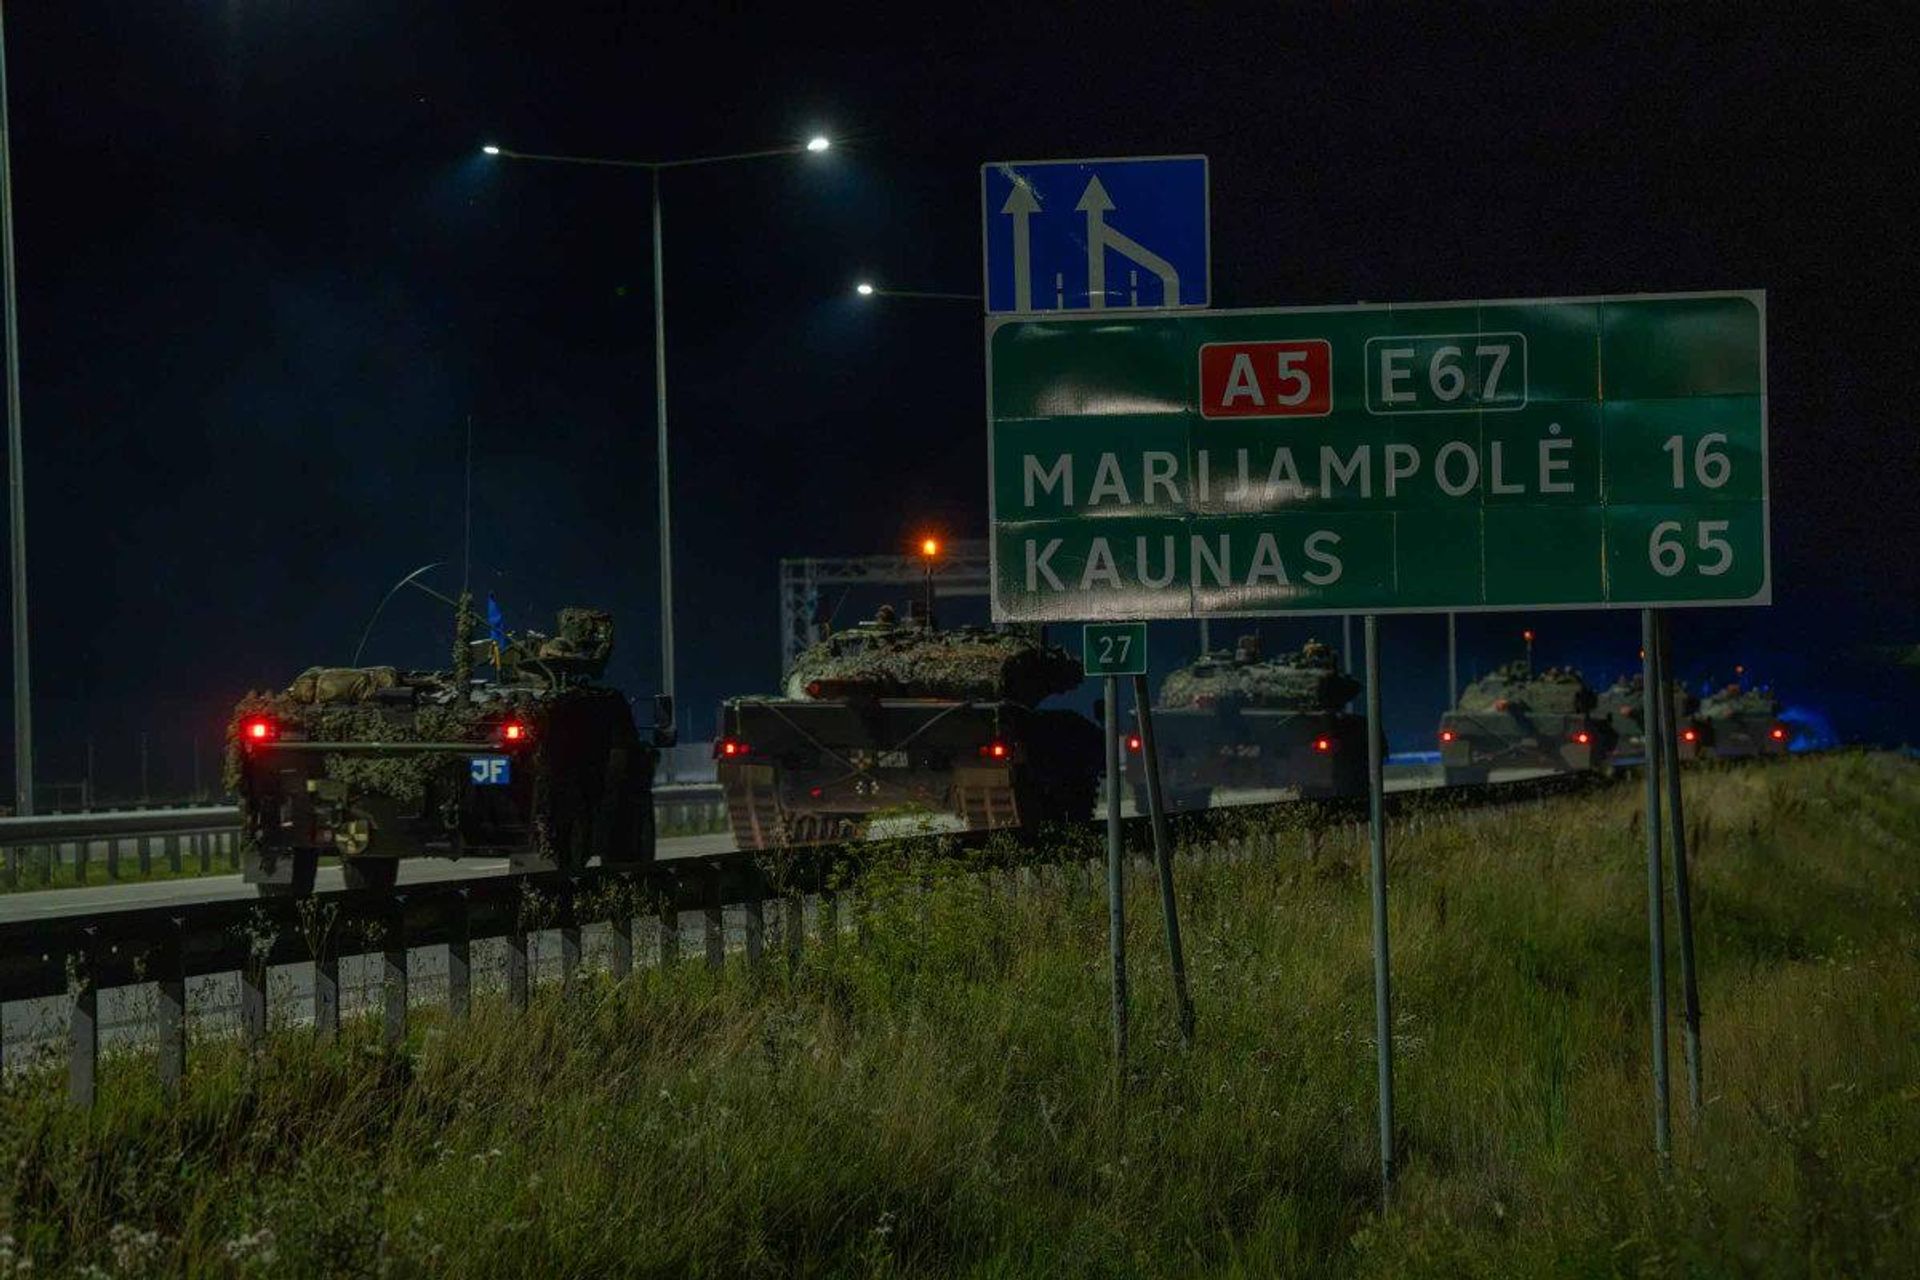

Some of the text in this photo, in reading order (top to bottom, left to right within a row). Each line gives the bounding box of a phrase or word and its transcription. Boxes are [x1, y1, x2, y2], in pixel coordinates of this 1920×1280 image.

[1220, 343, 1512, 408] A5 E67
[1022, 422, 1731, 508] MARIJAMPOLĖ 16
[1025, 519, 1734, 593] KAUNAS 65
[1098, 635, 1131, 664] 27
